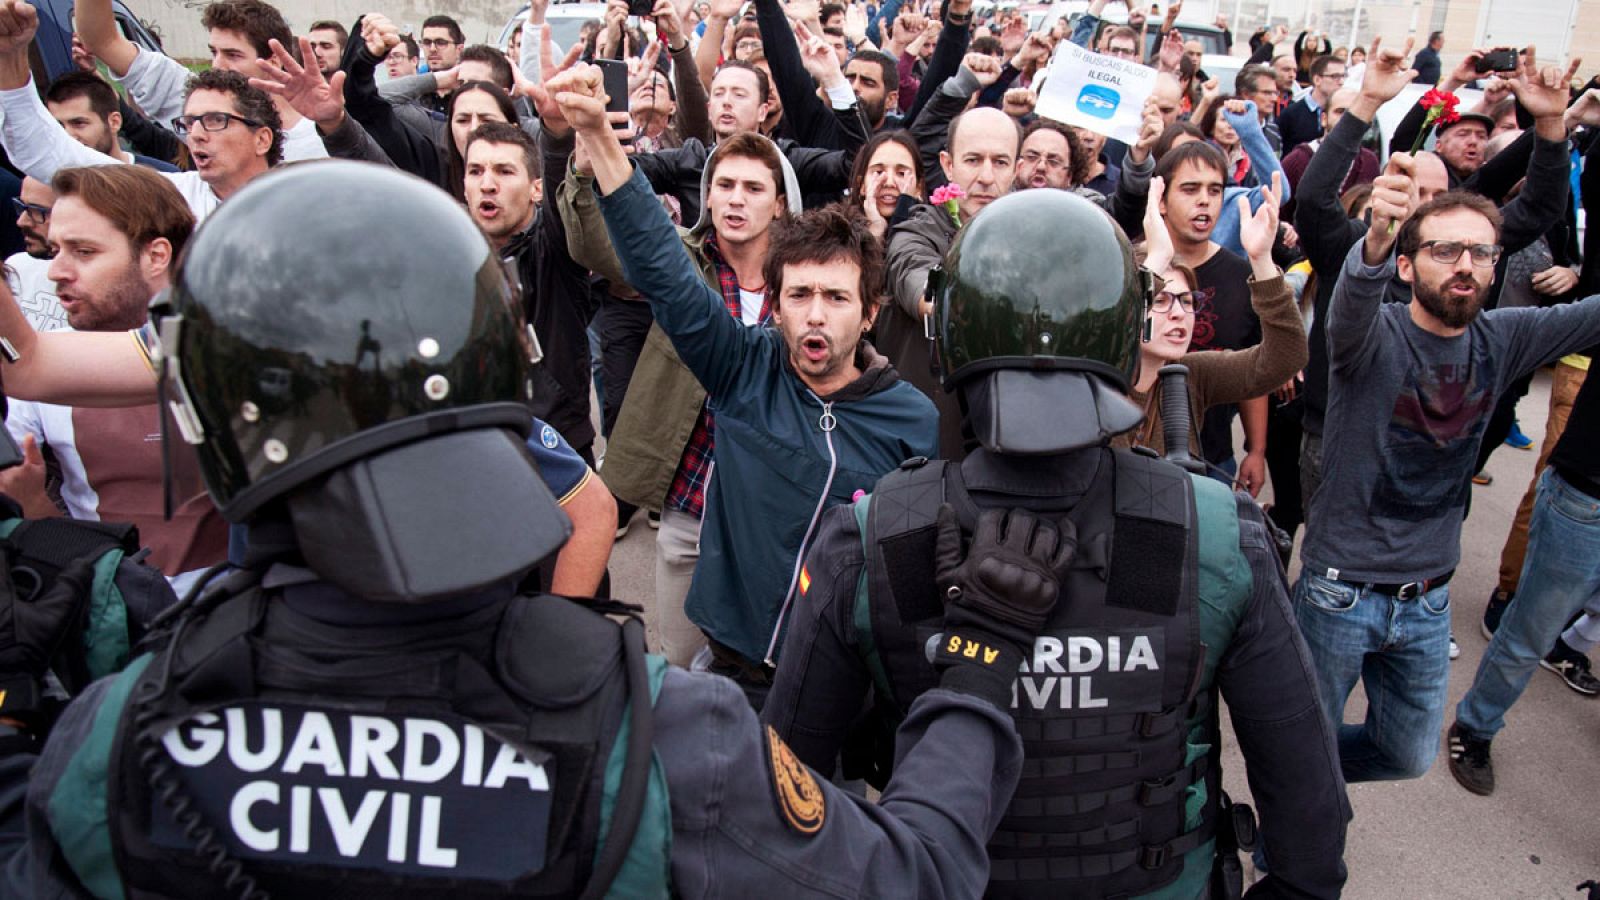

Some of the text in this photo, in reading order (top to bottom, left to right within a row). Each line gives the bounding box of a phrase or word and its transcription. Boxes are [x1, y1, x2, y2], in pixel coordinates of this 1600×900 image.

[1072, 48, 1148, 78] SI BUSCAIS ALGO
[1088, 70, 1122, 85] ILEGAL
[946, 635, 1000, 665] ARS
[161, 707, 550, 792] GUARDIA
[229, 780, 458, 868] CIVIL
